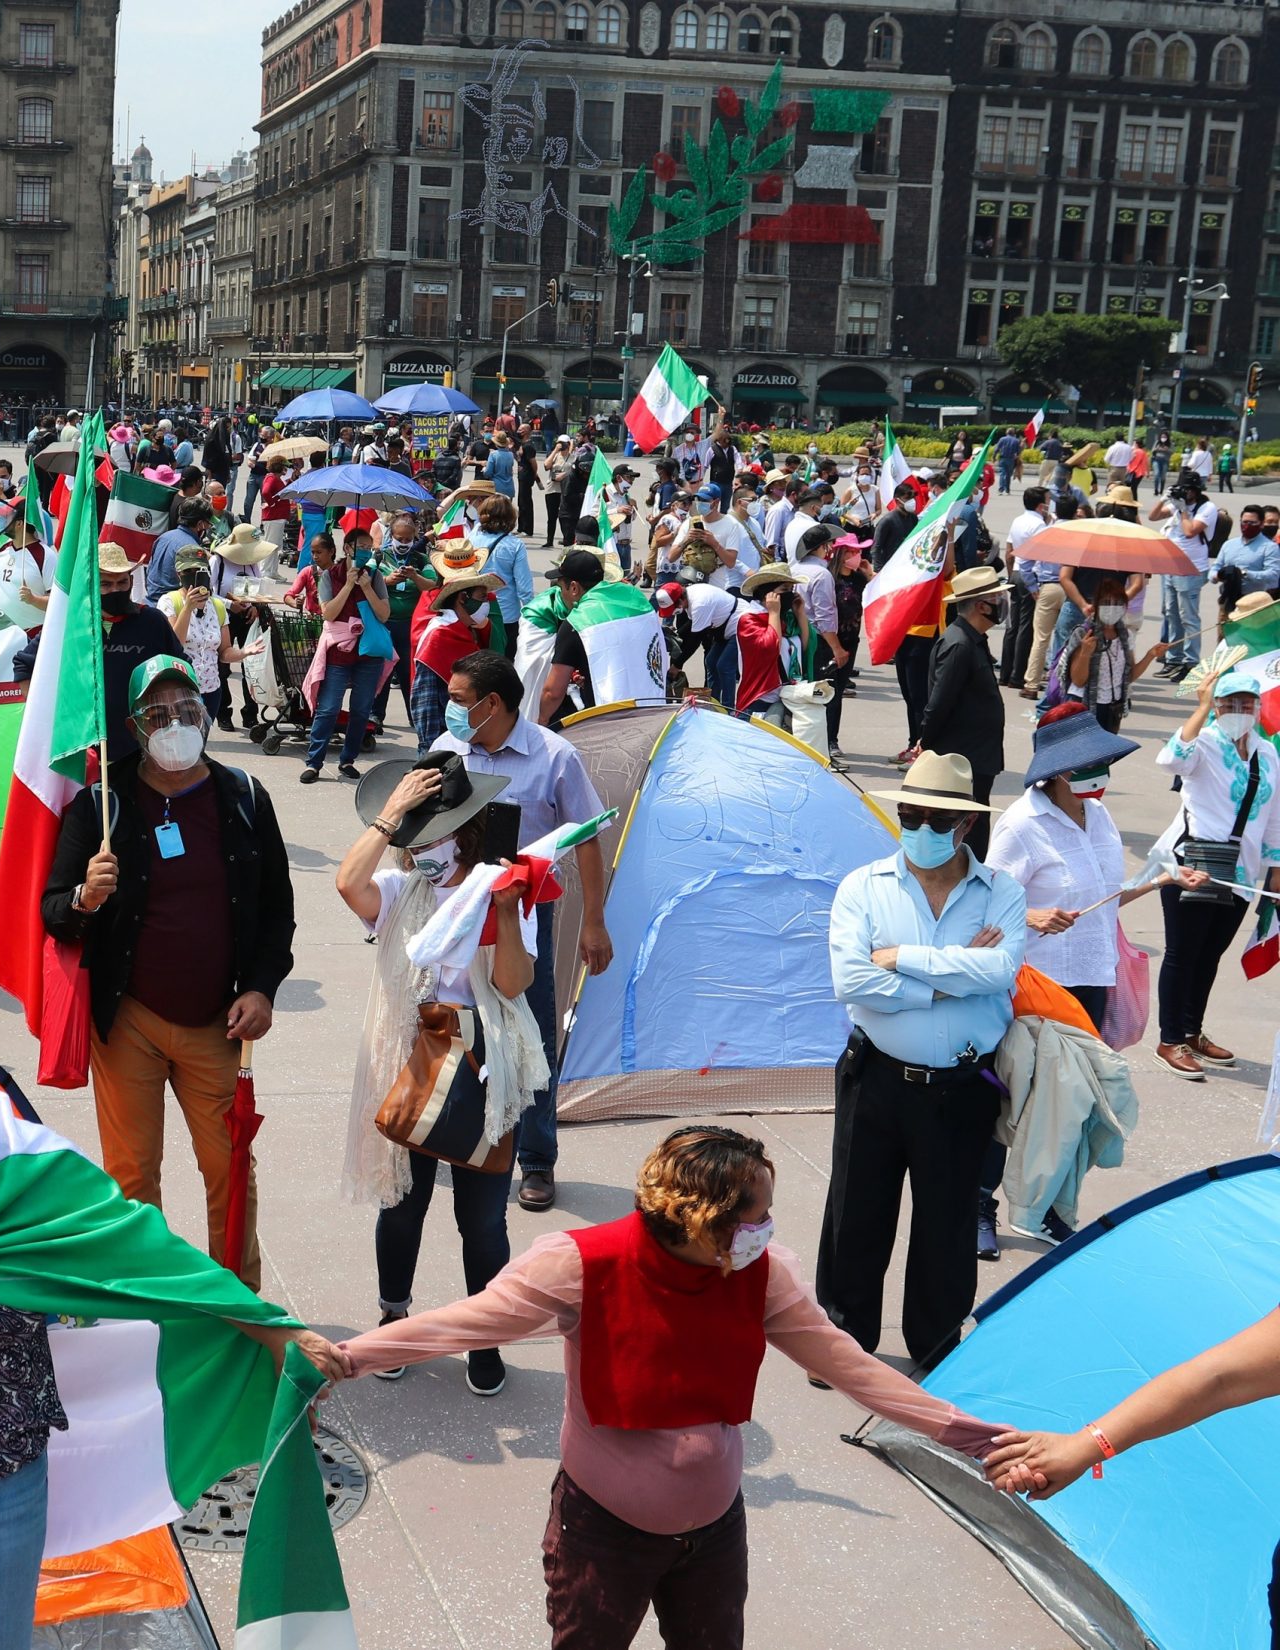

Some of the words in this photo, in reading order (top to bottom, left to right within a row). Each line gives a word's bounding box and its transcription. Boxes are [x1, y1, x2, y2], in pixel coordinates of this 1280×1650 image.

[389, 363, 452, 374] BIZZARRO
[737, 374, 797, 385] BIZZARRO
[414, 417, 437, 426] TACOS
[438, 417, 448, 426] DE
[413, 428, 448, 436] CANASTA
[2, 569, 13, 583] 12
